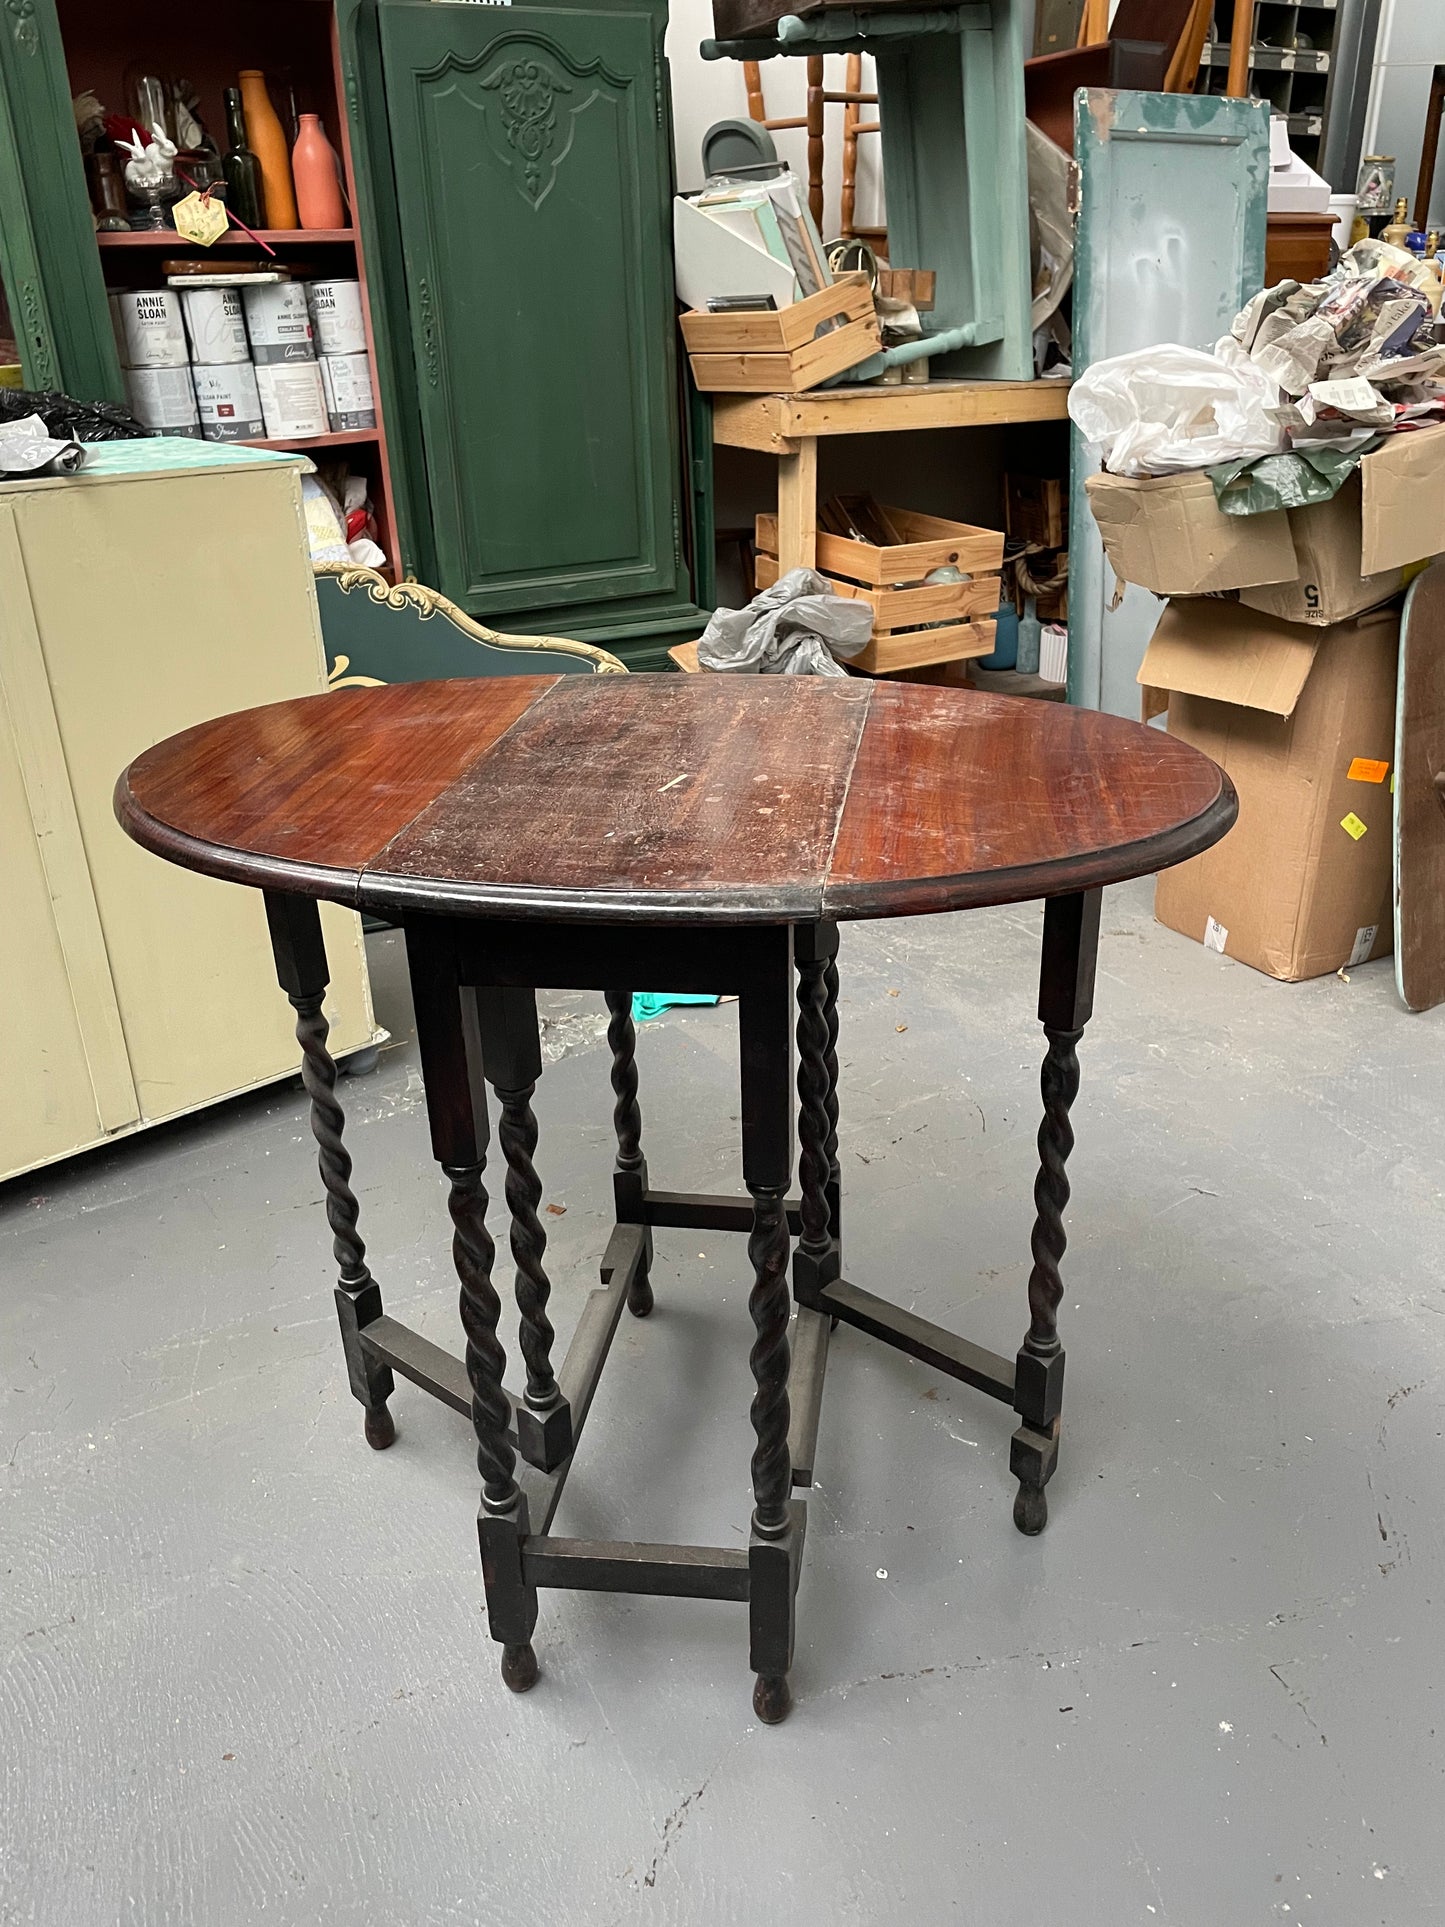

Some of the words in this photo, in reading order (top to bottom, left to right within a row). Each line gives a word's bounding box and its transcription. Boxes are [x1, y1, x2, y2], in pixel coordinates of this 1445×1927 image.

[136, 297, 165, 308] ANNIE
[137, 308, 167, 319] SLOAN
[1304, 584, 1319, 608] 5
[1304, 609, 1324, 619] SIZE
